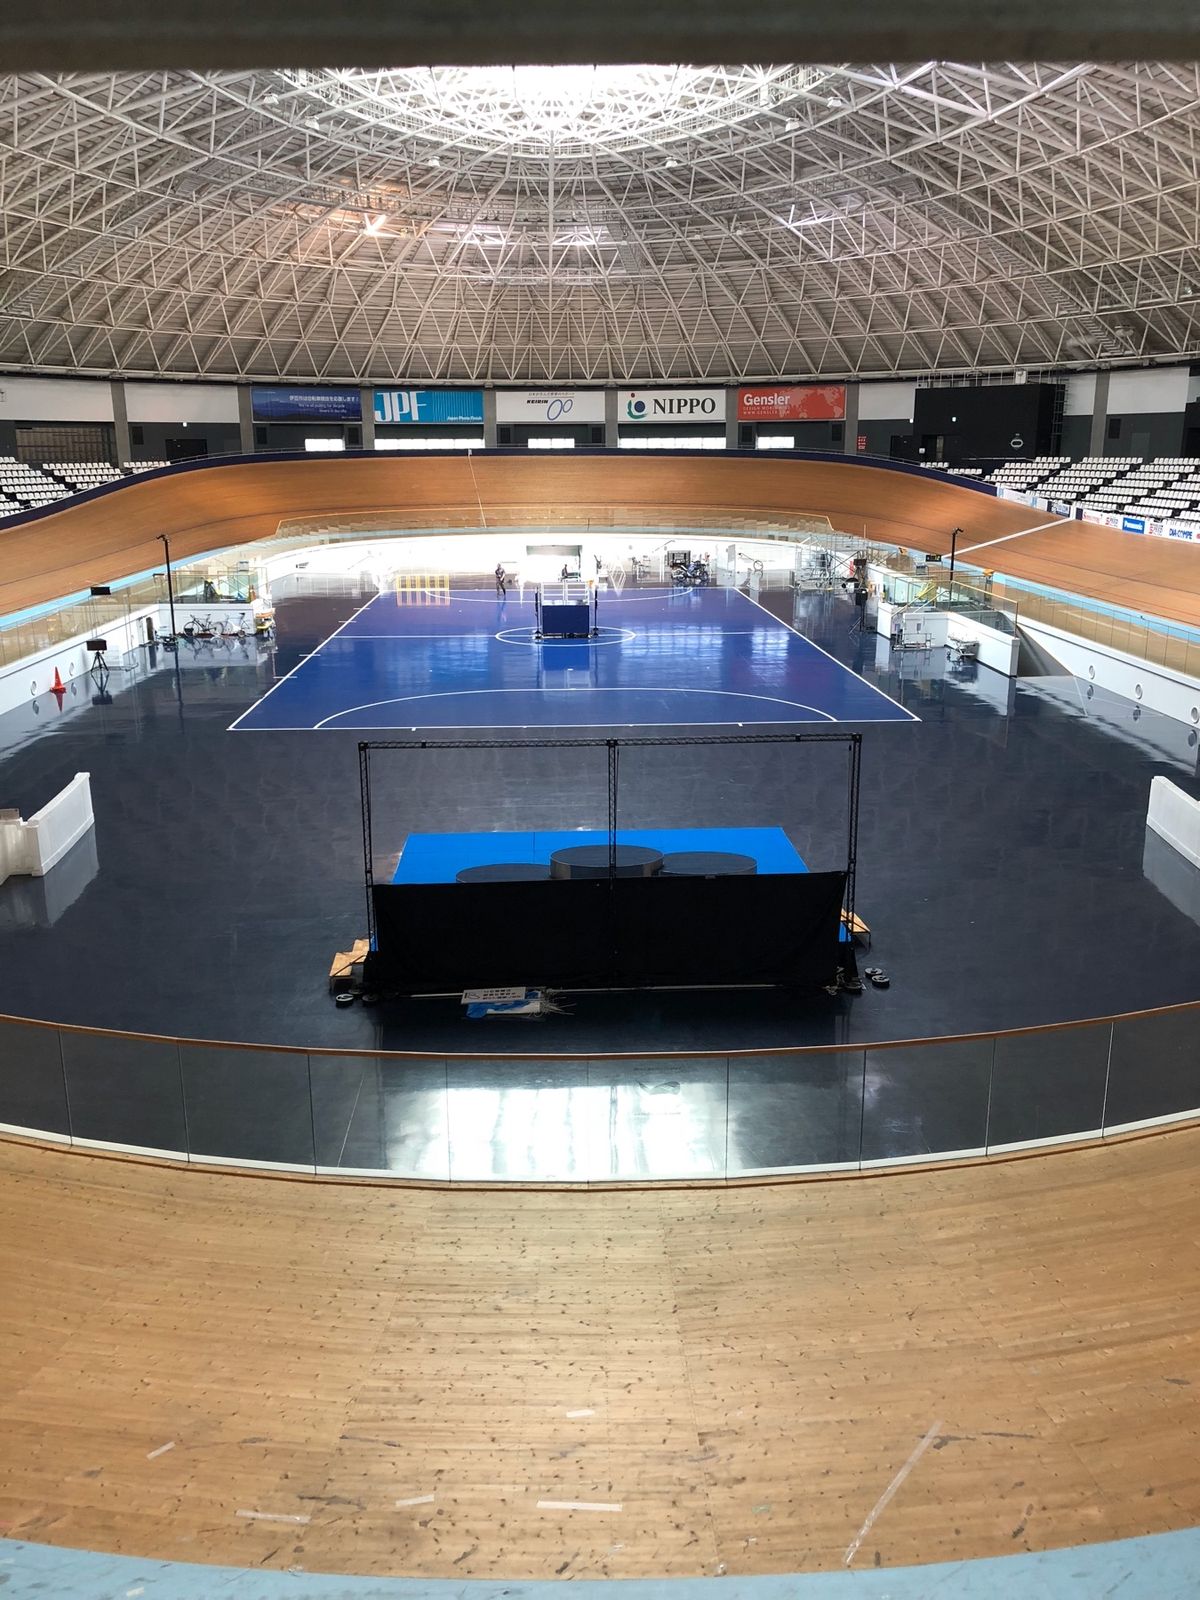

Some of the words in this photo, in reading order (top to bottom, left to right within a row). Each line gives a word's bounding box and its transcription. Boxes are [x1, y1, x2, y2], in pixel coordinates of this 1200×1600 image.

[374, 391, 426, 422] JPF
[652, 397, 716, 415] NIPPO
[743, 392, 790, 406] Gensler
